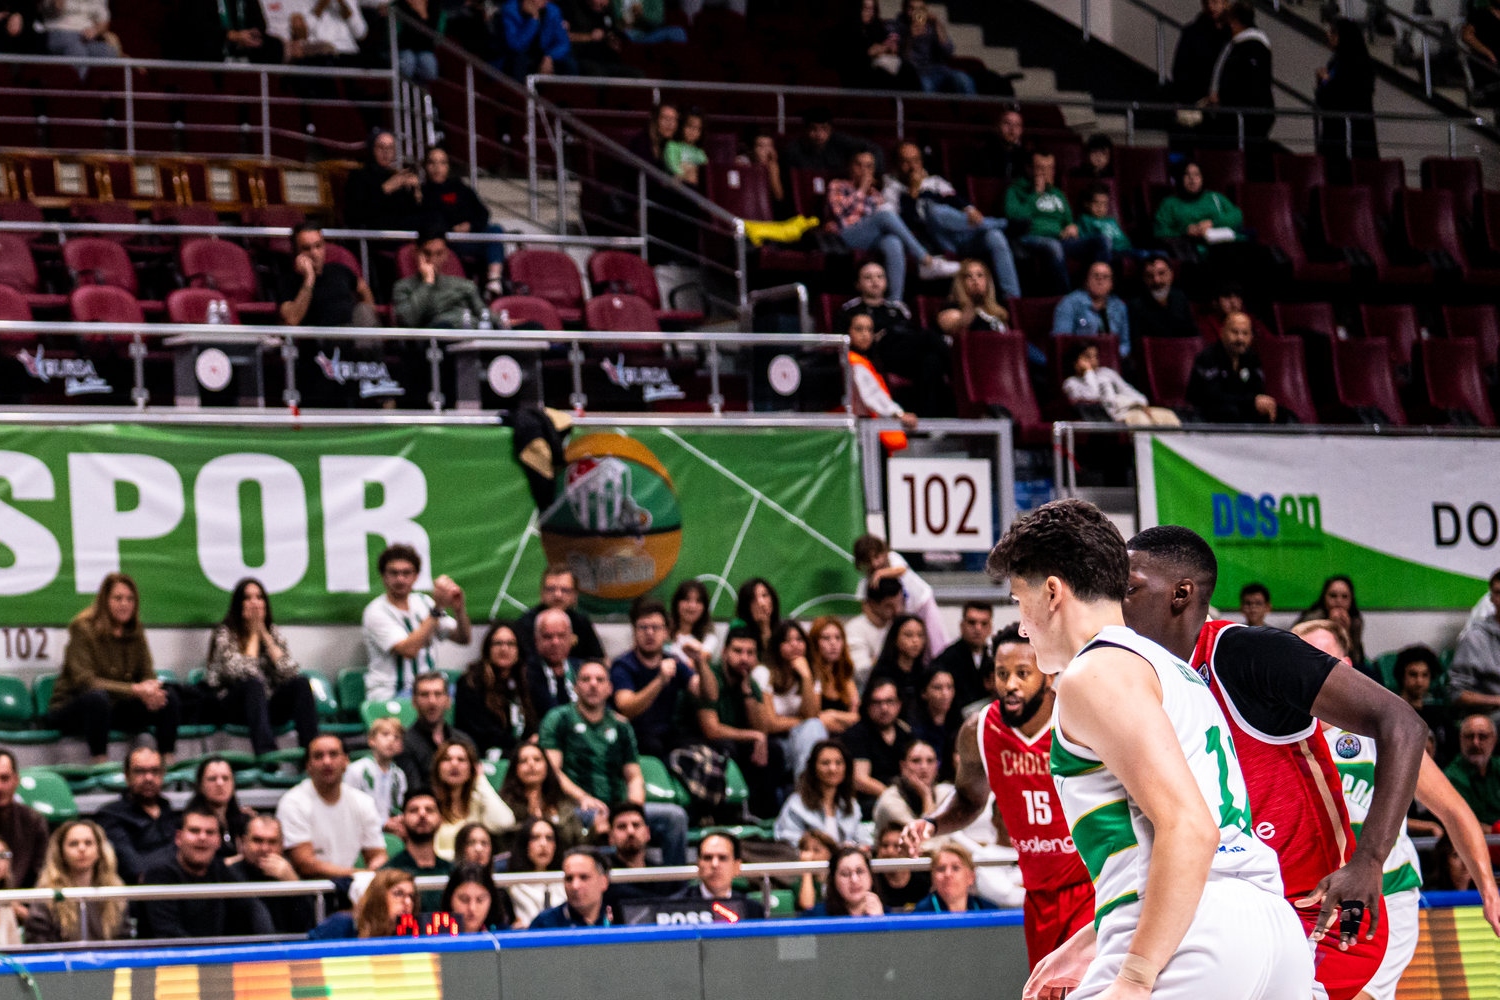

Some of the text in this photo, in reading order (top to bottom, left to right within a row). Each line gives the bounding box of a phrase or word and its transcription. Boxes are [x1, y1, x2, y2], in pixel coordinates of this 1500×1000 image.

[902, 474, 979, 535] 102
[2, 627, 49, 659] 102
[1021, 790, 1053, 825] 15
